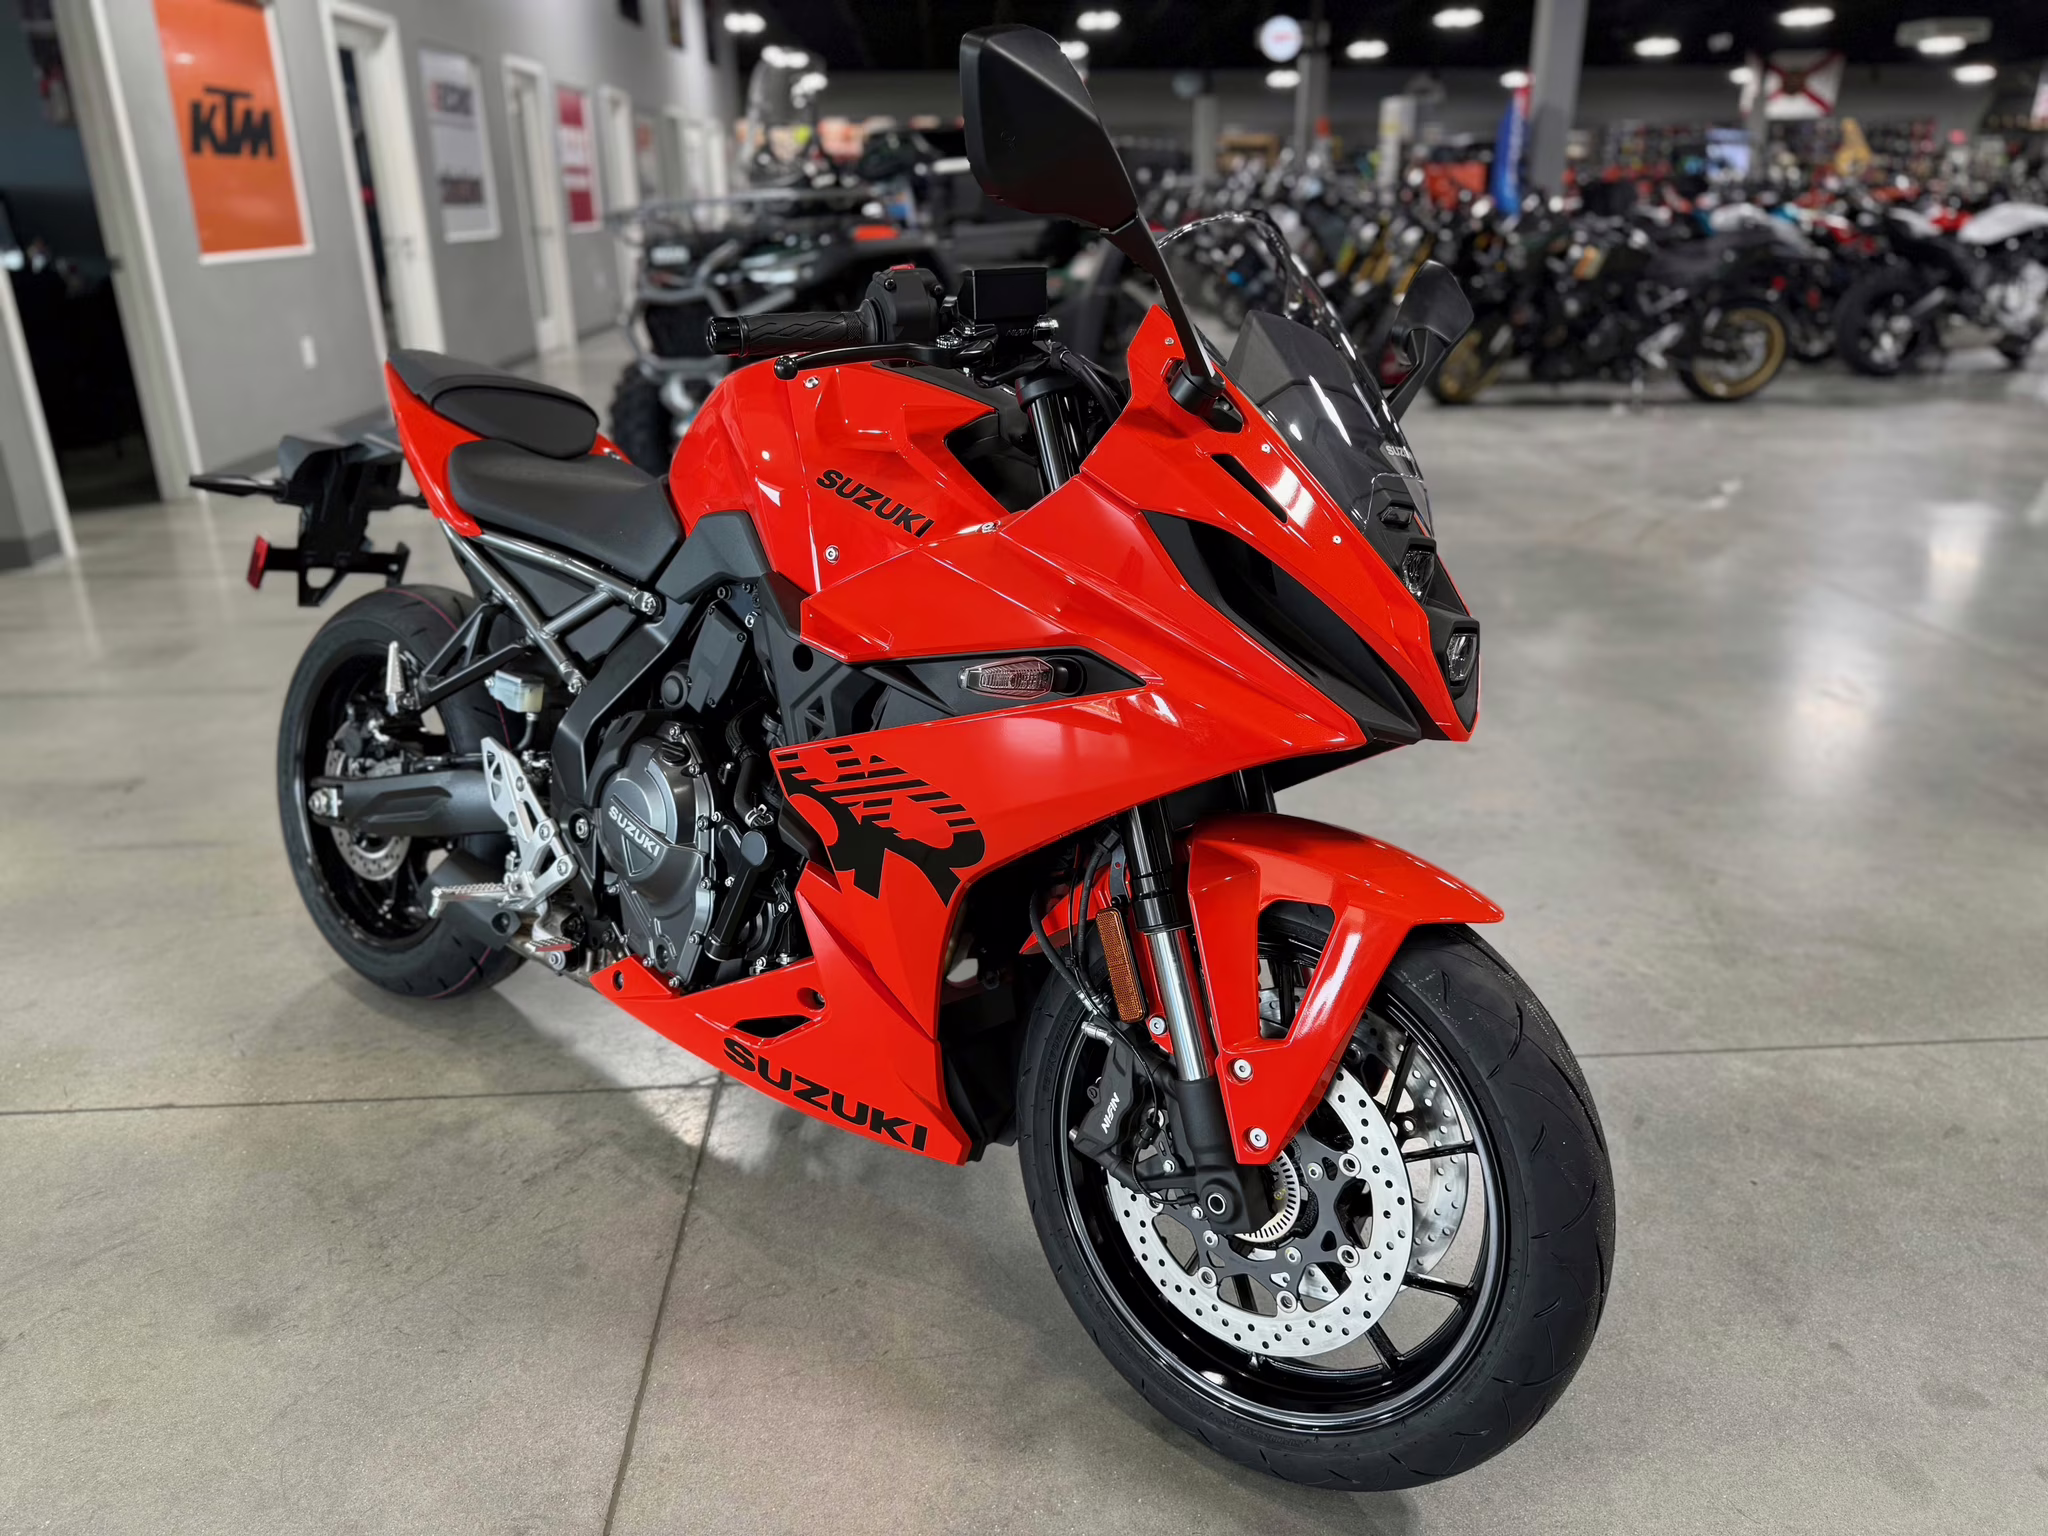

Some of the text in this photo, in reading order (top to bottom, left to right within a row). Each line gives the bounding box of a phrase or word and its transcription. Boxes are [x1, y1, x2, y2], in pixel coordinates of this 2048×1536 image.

[191, 87, 273, 158] KTM
[816, 469, 935, 538] SUZUKI
[608, 805, 661, 857] SUZUKI
[723, 1037, 928, 1152] SUZUKI
